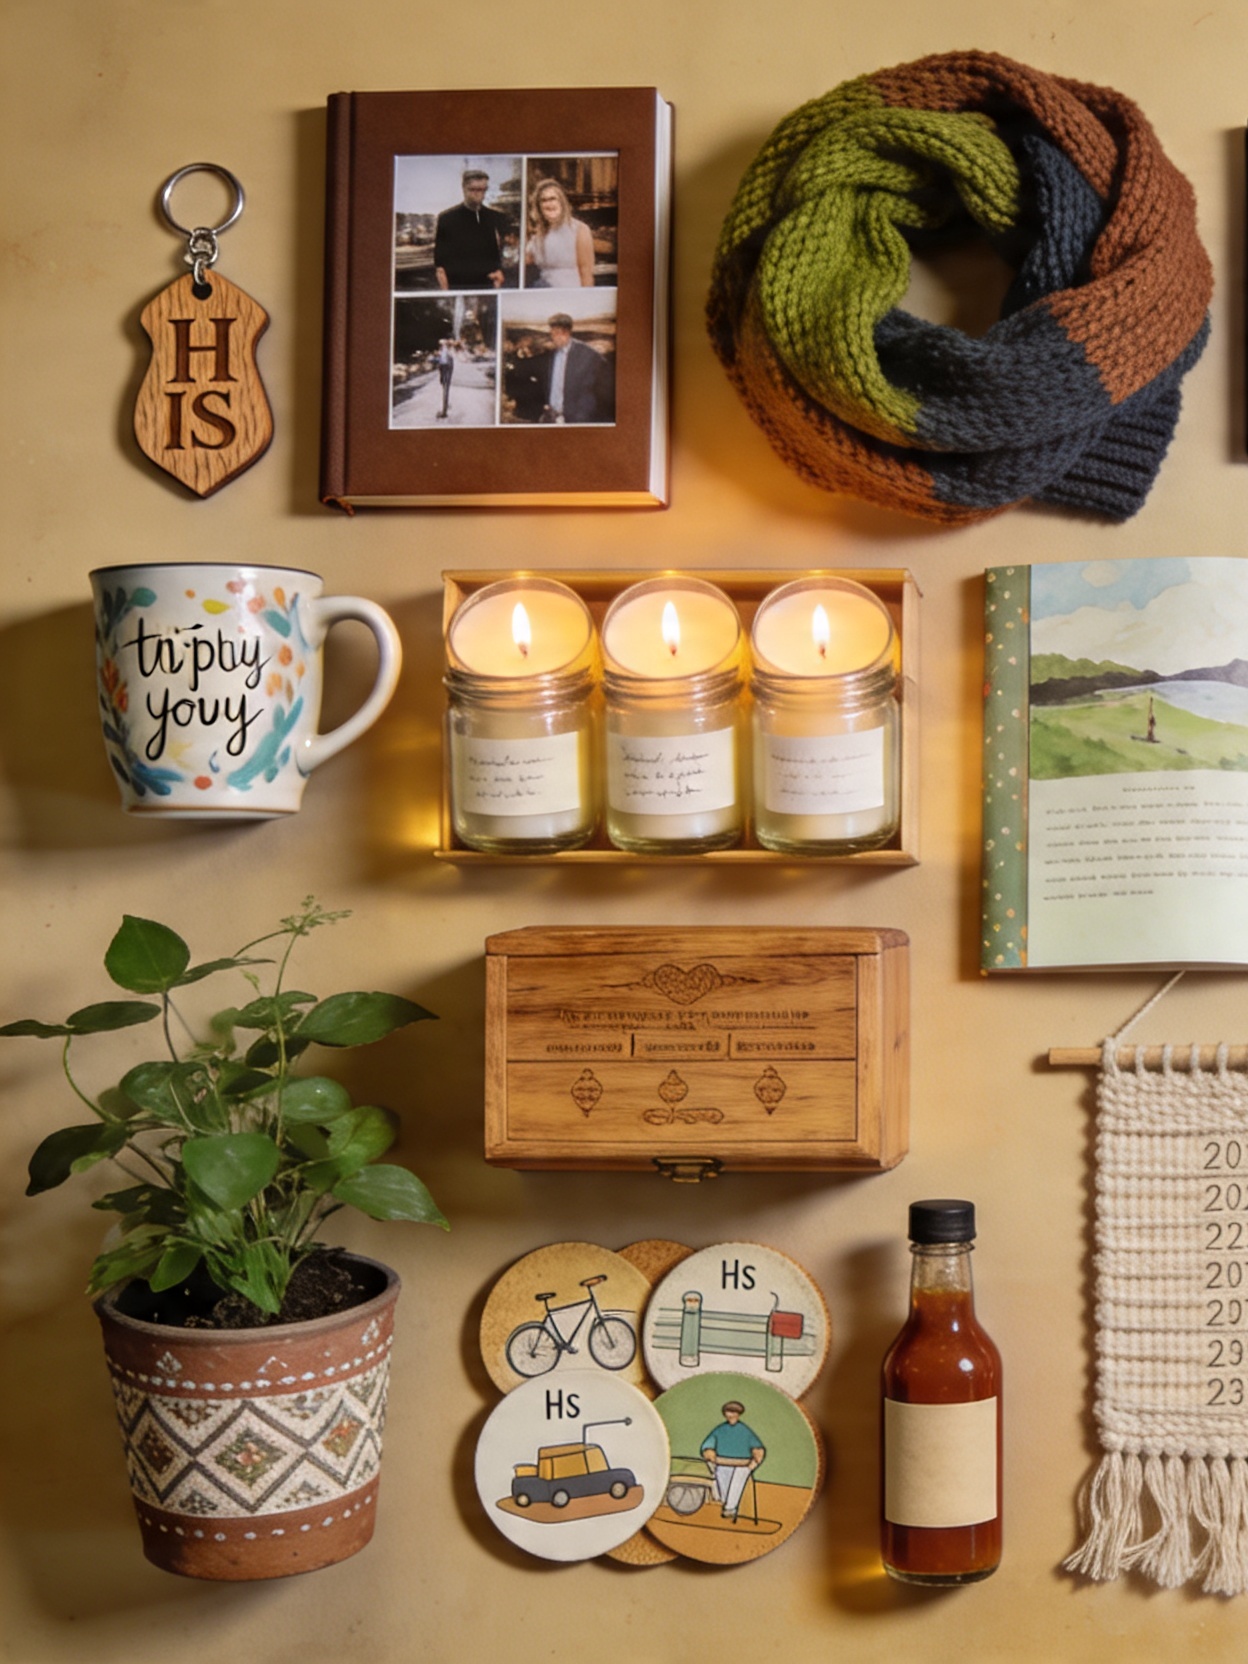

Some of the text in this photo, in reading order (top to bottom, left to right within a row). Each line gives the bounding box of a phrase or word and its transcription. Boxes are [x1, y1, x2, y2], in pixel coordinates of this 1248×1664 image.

[166, 317, 239, 384] H
[164, 389, 236, 451] IS
[721, 1259, 757, 1290] Hs
[545, 1389, 581, 1421] Hs
